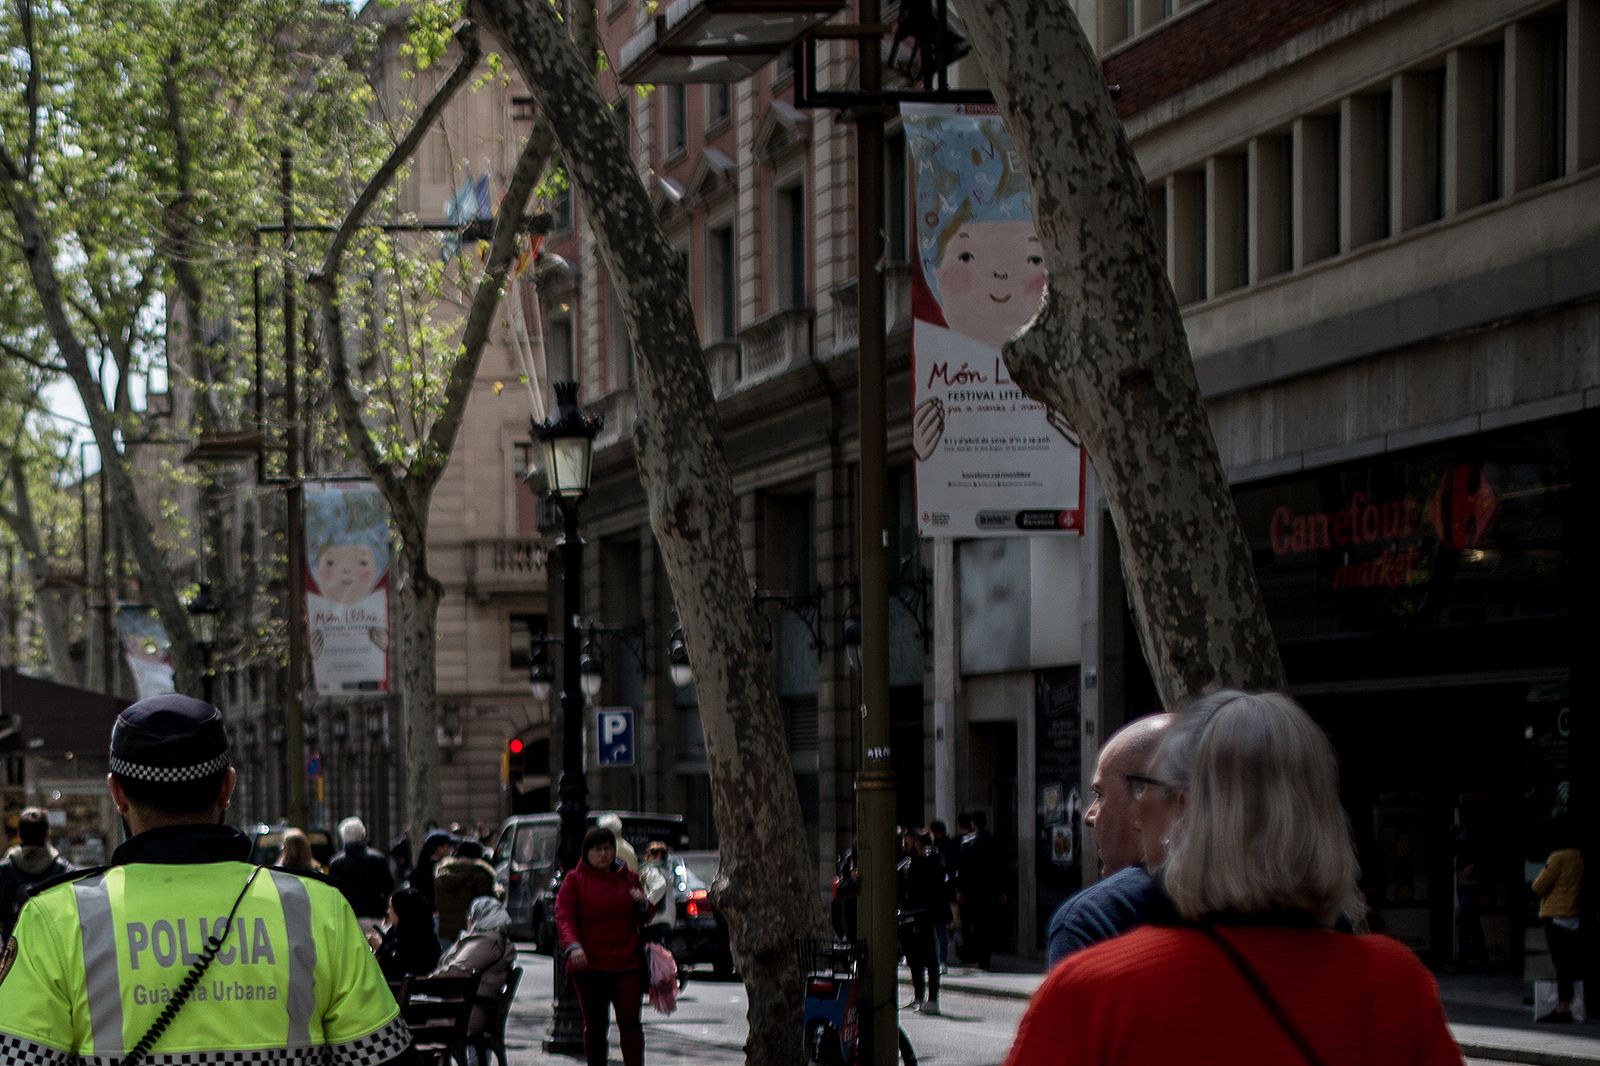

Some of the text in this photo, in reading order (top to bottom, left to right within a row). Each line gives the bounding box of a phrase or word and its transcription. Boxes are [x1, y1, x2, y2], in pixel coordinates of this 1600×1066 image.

[928, 360, 988, 389] Món
[948, 390, 995, 401] FESTIVAL
[1270, 491, 1417, 555] Carrefour
[605, 715, 627, 745] P
[126, 917, 275, 970] POLICIA
[133, 980, 277, 1006] Guàia Urbana
